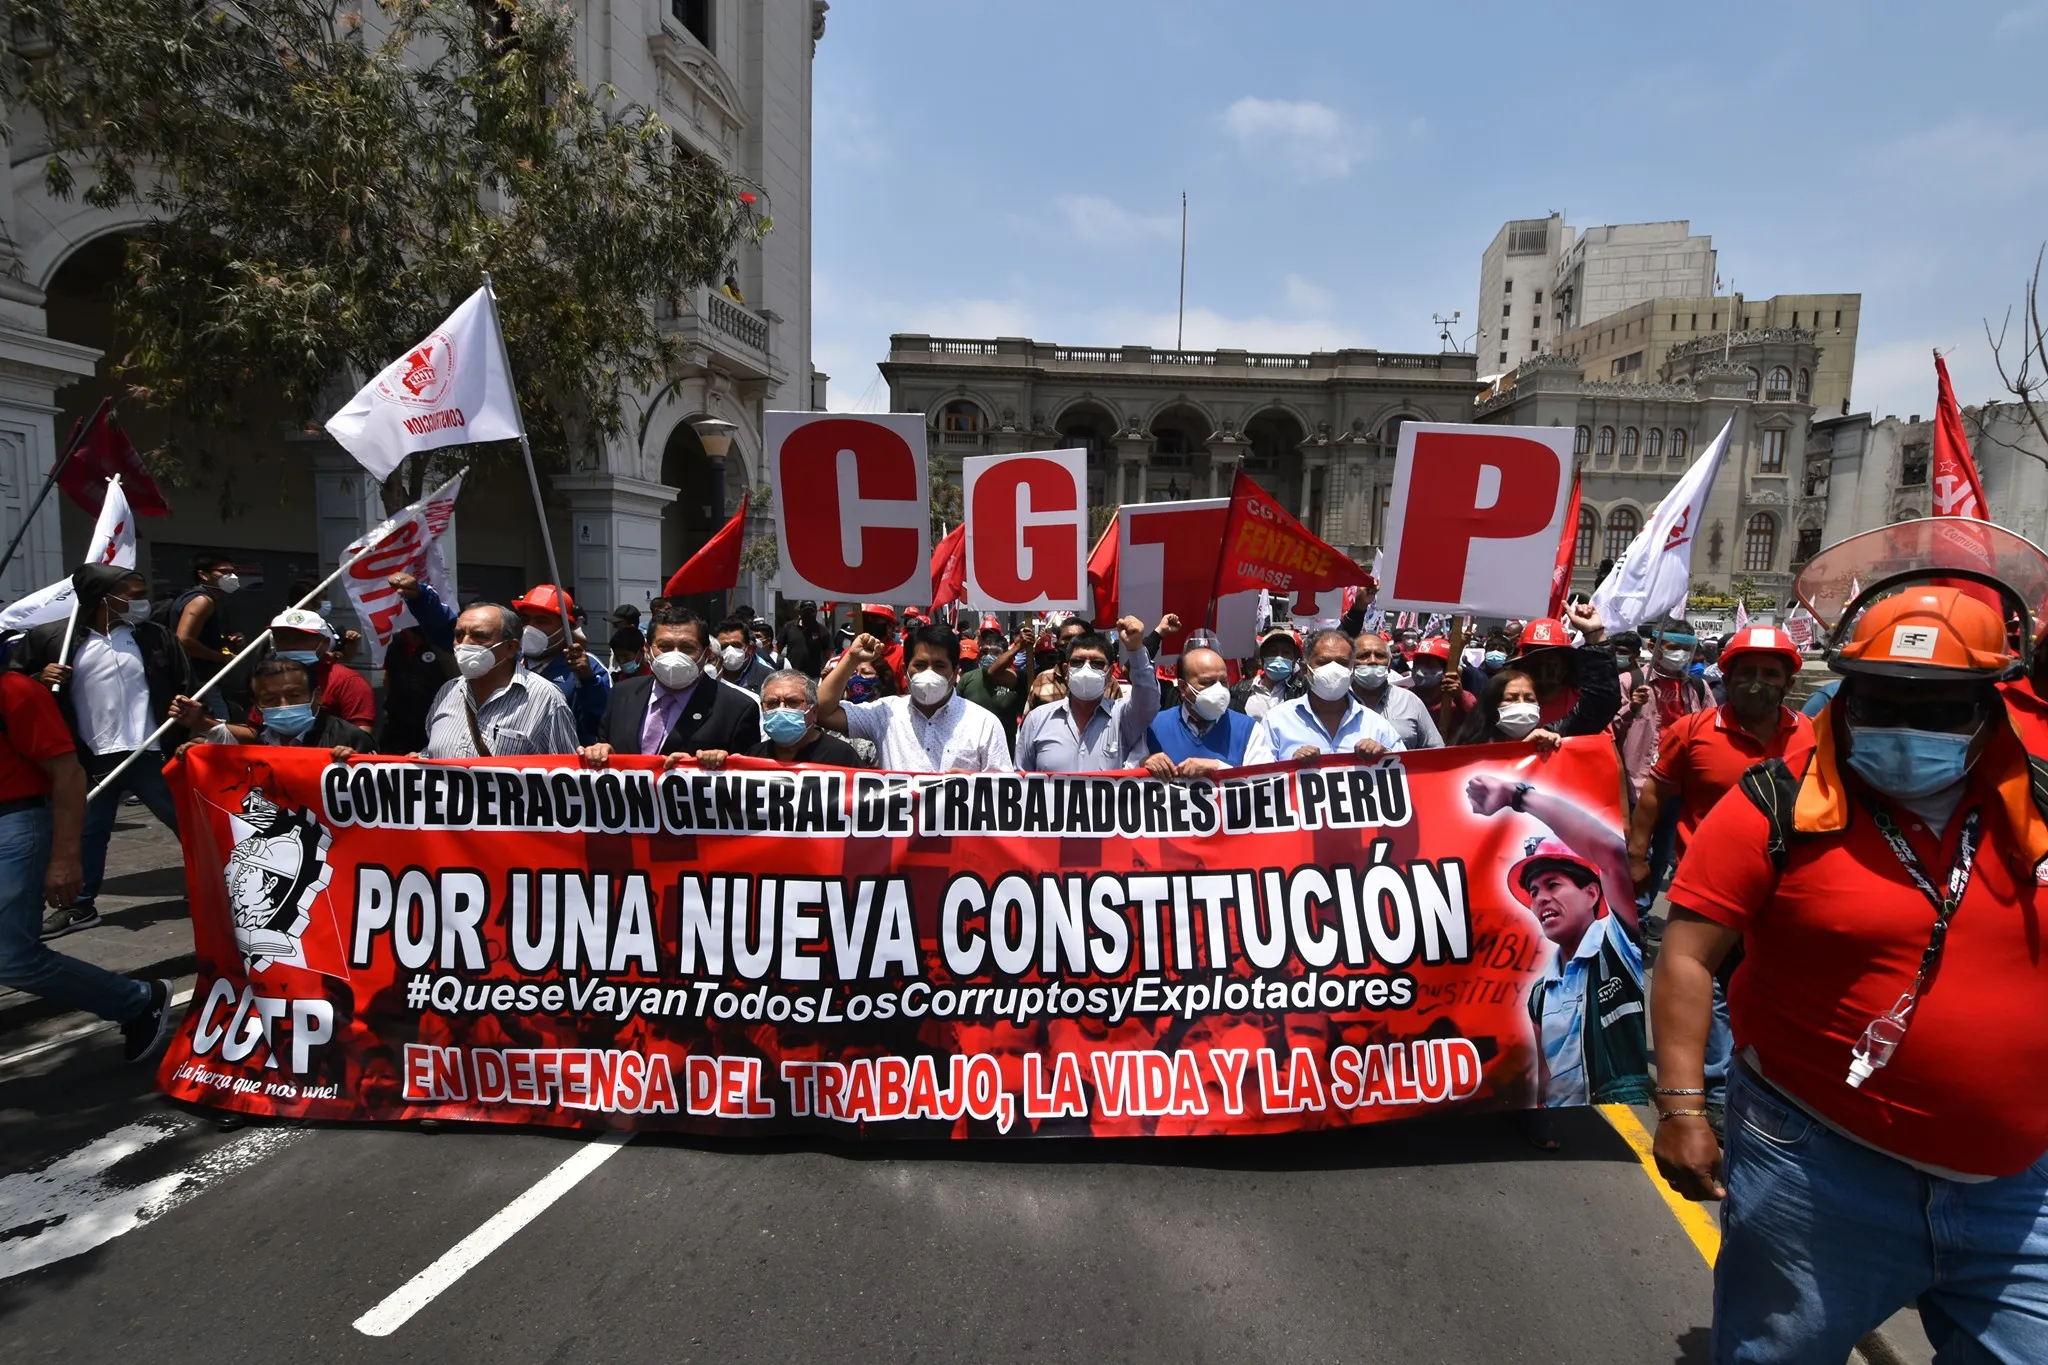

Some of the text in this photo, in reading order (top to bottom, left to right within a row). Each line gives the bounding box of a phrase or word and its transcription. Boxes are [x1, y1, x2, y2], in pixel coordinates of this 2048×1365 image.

[779, 417, 920, 594] C
[973, 457, 1078, 604] G
[1234, 520, 1332, 578] FENTASE
[1392, 432, 1560, 605] P
[1237, 561, 1293, 590] UNASSE
[1694, 620, 1723, 632] SANDWICH
[323, 757, 1410, 835] CONFEDERACION GENERAL DE TRABAJADORES DEL PERÚ
[352, 842, 1469, 982] POR UNA NUEVA CONSTITUCIÓN
[192, 977, 334, 1075] CGTP
[405, 973, 1413, 1024] #QueseVayanTodosLosCorruptosyExplotadores
[173, 1060, 339, 1100] ¡La Fuerza que nos une!
[404, 1036, 1483, 1134] EN DEFENSA DEL TRABAJO, LA VIDA Y LA SALUD
